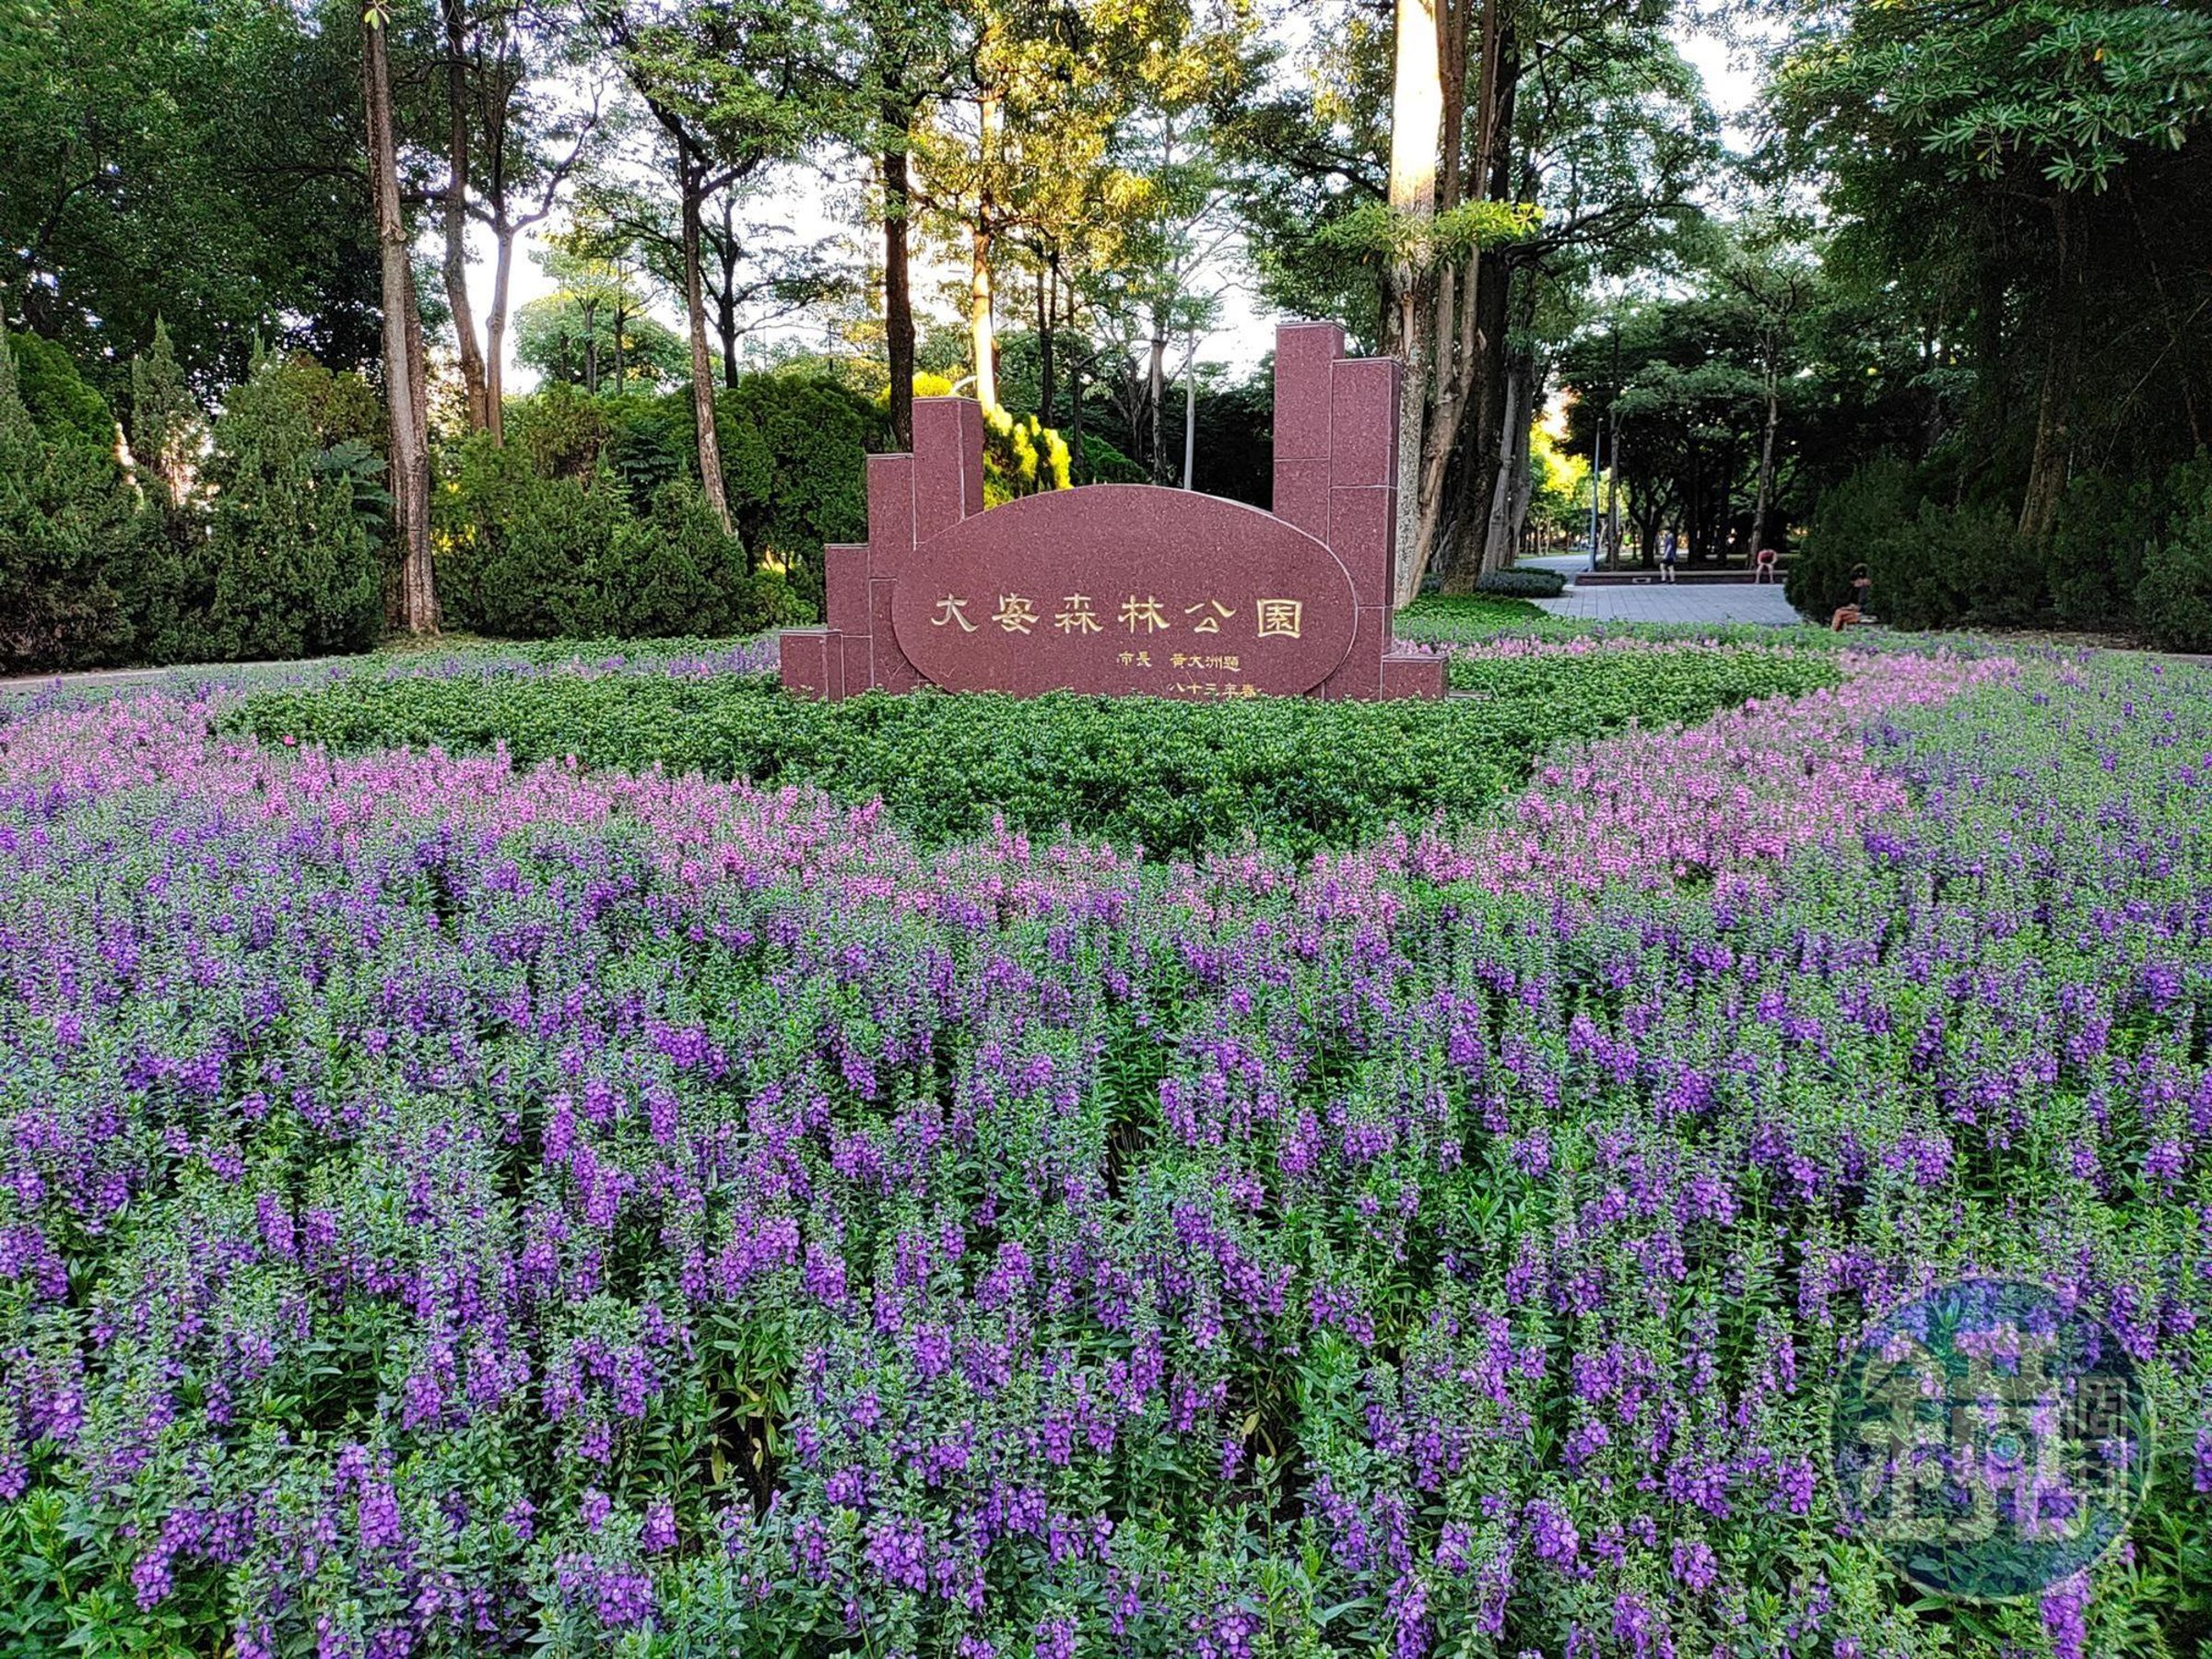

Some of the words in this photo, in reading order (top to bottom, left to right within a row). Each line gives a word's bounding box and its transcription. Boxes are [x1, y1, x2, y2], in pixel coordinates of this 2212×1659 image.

[931, 593, 1303, 639] 大安森林公園
[1117, 651, 1152, 667] 市長
[1169, 653, 1241, 672] 黃大洲題
